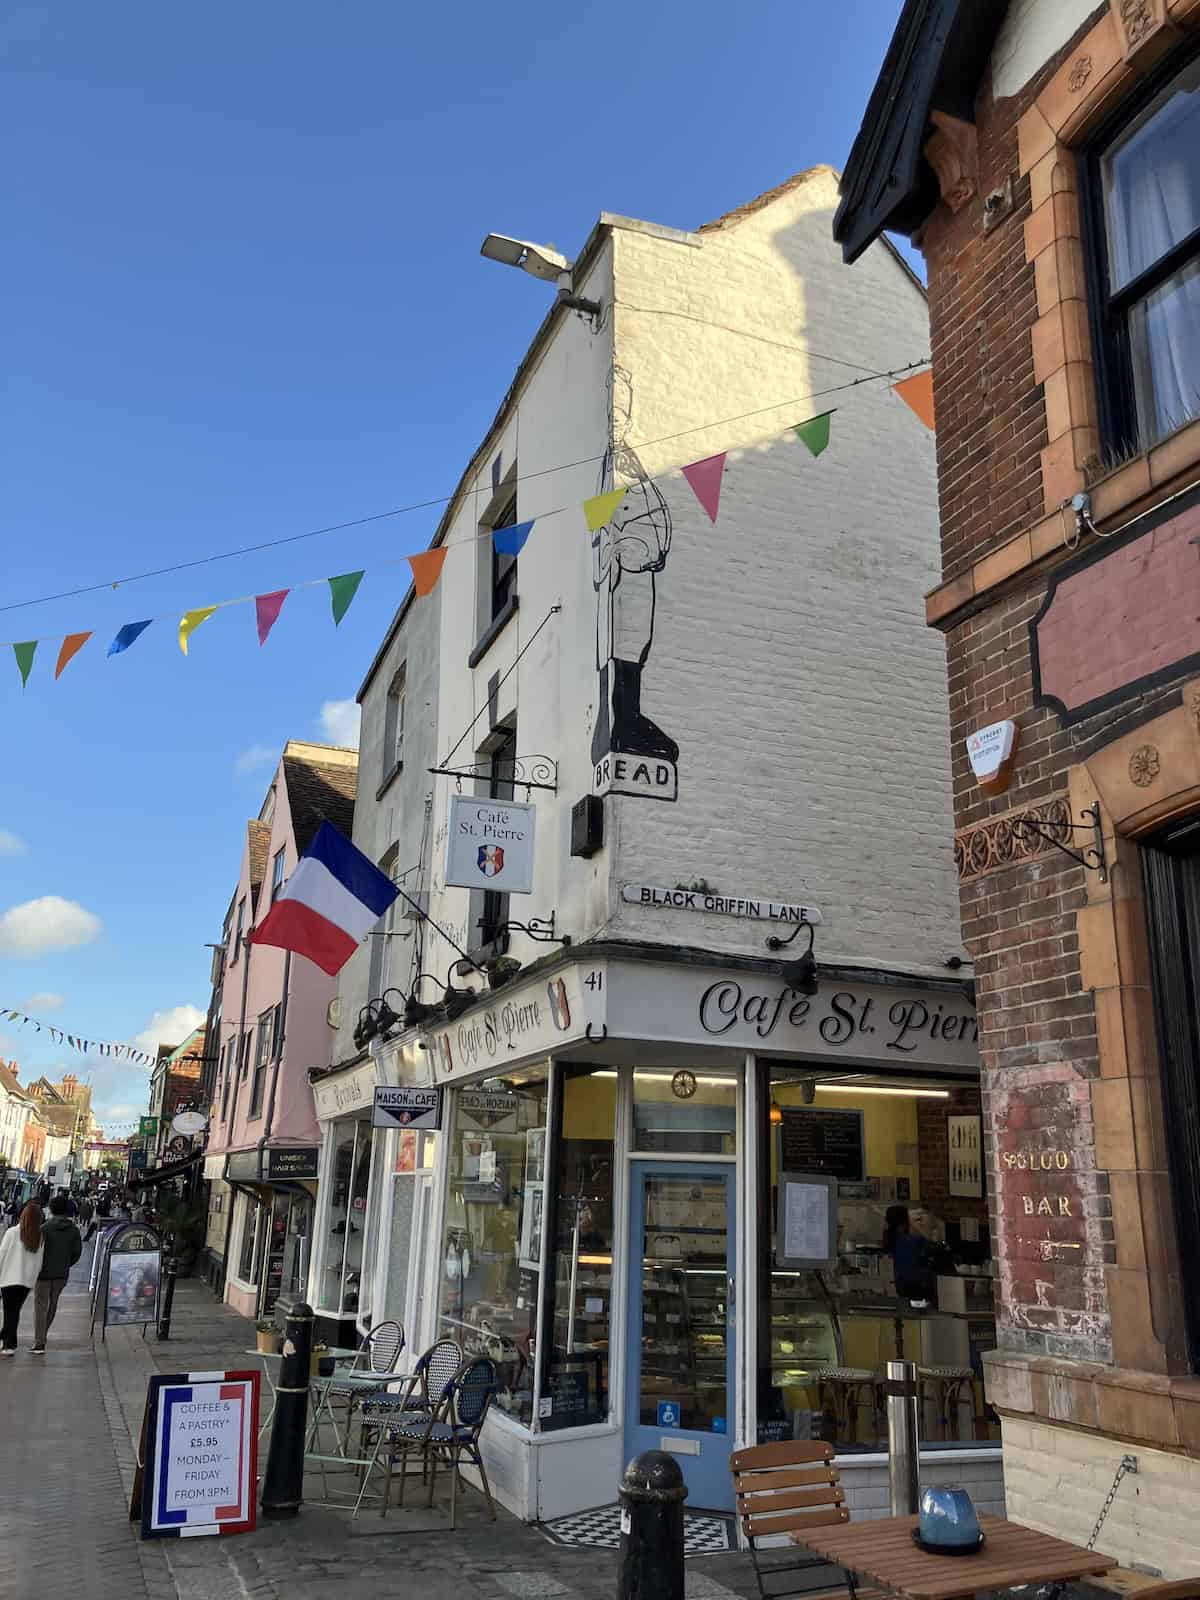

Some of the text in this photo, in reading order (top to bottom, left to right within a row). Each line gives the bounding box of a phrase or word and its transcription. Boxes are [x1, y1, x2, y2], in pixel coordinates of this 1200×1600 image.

[596, 759, 669, 787] BREAD
[477, 808, 510, 825] Café
[483, 823, 525, 841] Pierre
[641, 887, 808, 922] BLACK GRIFFIN LANE
[584, 971, 602, 991] 41
[502, 1001, 541, 1049] Pierre
[819, 993, 876, 1046] St.
[376, 1092, 408, 1105] MAISON
[1022, 1196, 1072, 1216] BAR
[180, 1402, 221, 1414] COFFEE
[179, 1421, 186, 1431] A
[190, 1437, 218, 1448] £5.95
[176, 1454, 222, 1465] MONDAY
[184, 1470, 221, 1481] FRIDAY
[174, 1488, 205, 1500] FROM
